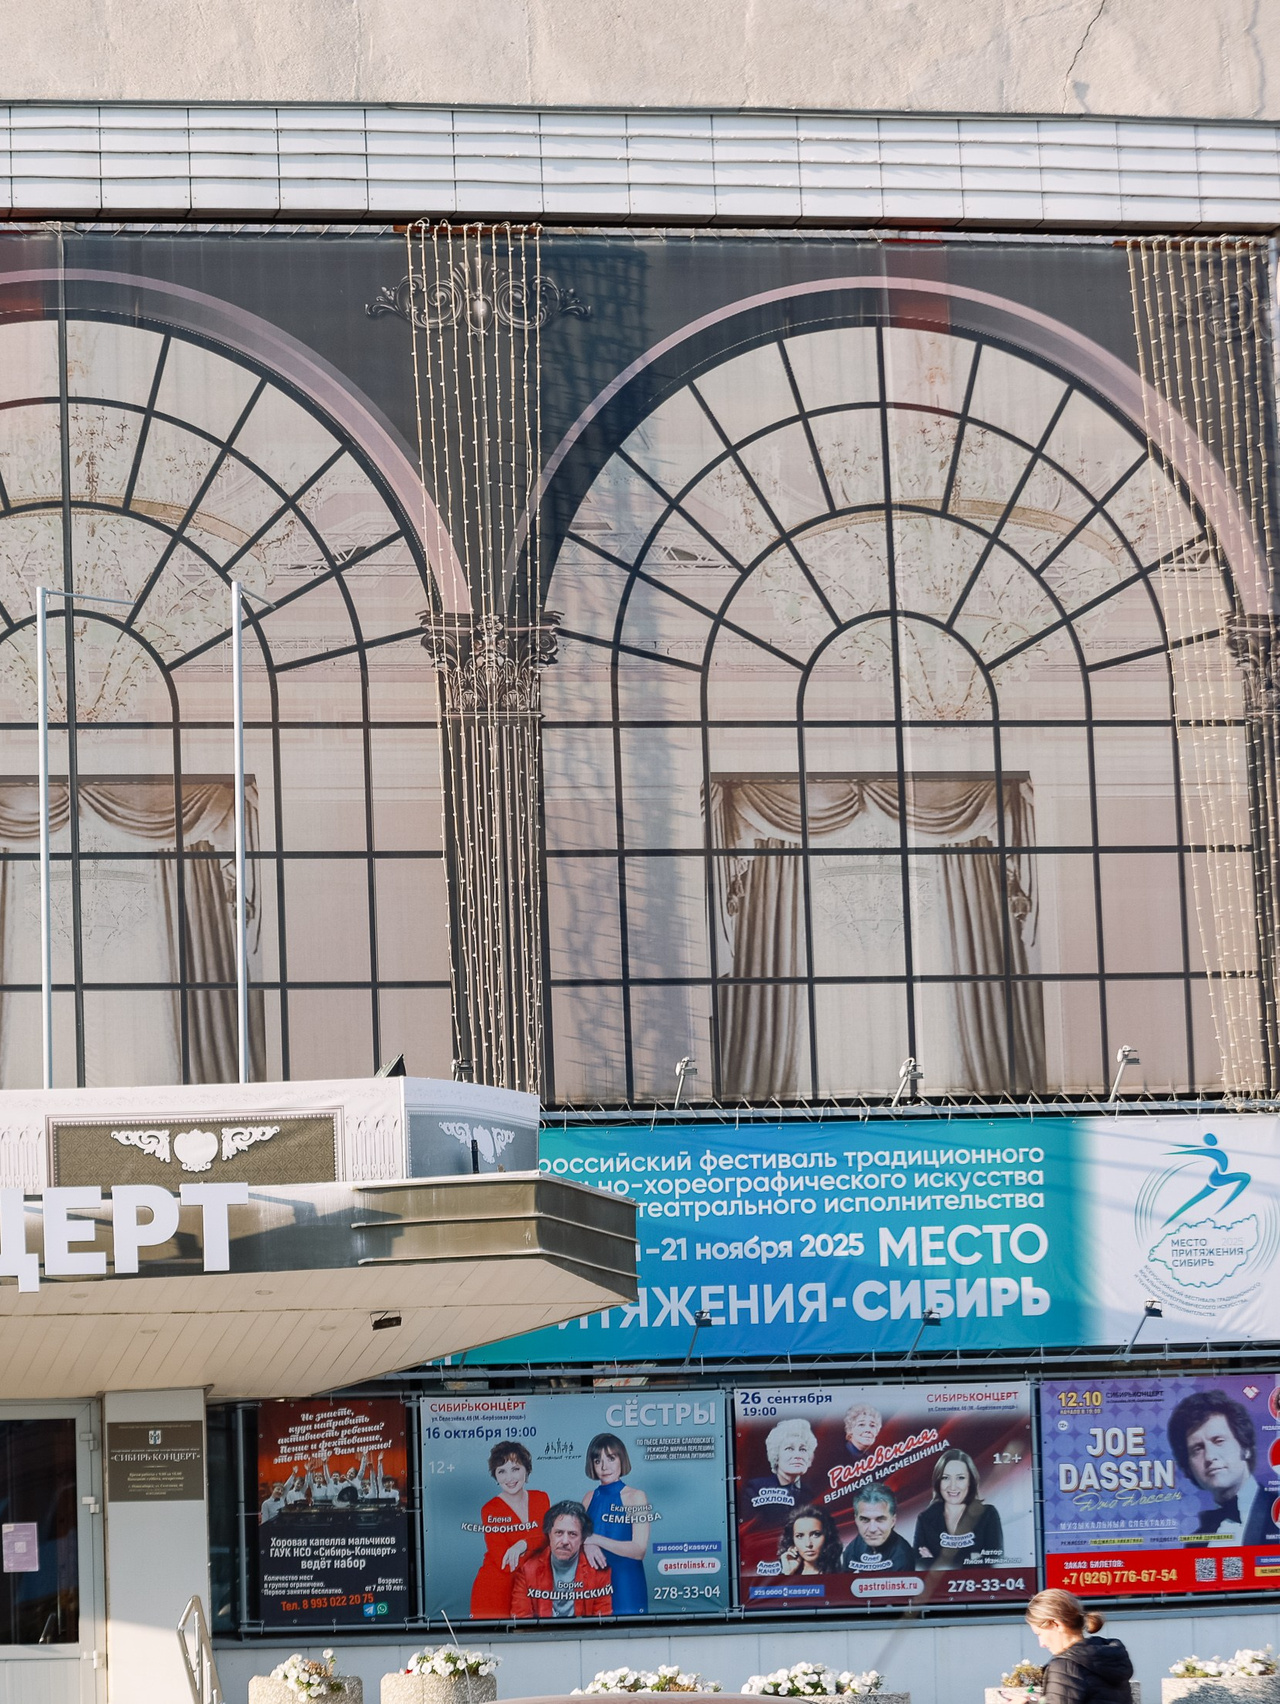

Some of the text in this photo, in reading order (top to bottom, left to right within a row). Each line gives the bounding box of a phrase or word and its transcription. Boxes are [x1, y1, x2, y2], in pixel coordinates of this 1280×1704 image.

[699, 1149, 838, 1176] фестиваль
[844, 1147, 1045, 1172] традиционного
[913, 1169, 1045, 1192] искусства
[824, 1192, 1045, 1213] исполнительства
[695, 1235, 793, 1264] ноября
[799, 1233, 865, 1258] 2025
[878, 1223, 1049, 1267] МЕСТО
[1171, 1238, 1207, 1247] МЕСТО
[1171, 1247, 1244, 1258] ПРИТЯЖЕНИЯ
[1171, 1258, 1214, 1267] СИБИРЬ
[740, 1391, 832, 1405] 26 сентября
[926, 1391, 1019, 1403] СИБИРЬКОНЦЕРТ
[1058, 1391, 1102, 1407] 12.10
[430, 1401, 526, 1413] СИБИРЬКОНЦЕРТ
[605, 1399, 716, 1427] СЁСТРЫ
[743, 1406, 777, 1416] 19:00
[425, 1426, 537, 1441] 16 октября 19:00
[1086, 1427, 1146, 1458] JOE
[992, 1453, 1022, 1464] 12+
[428, 1461, 455, 1474] 12+
[823, 1439, 951, 1504] ВЕЛИКАЯ НАСМЕШНИЦА
[1058, 1460, 1175, 1493] DASSIN
[610, 1503, 653, 1514] Екатерина
[487, 1515, 512, 1524] Елена
[601, 1511, 662, 1525] СЕМЁНОВА
[461, 1520, 539, 1534] КСЕНОФОНТОВА
[270, 1536, 396, 1548] Хоровая капелла мальчиков
[270, 1548, 291, 1558] ГАУК
[293, 1548, 311, 1557] НСО
[301, 1557, 366, 1570] ведёт набор
[664, 1560, 716, 1571] gastrolinsk.ru
[1064, 1559, 1125, 1569] ЗАКАЗ БИЛЕТОВ:
[948, 1577, 1025, 1592] 278-33-04
[1062, 1568, 1178, 1587] +7 (926) 776-67-54
[526, 1584, 614, 1601] ХВОШНЯНСКИЙ
[558, 1581, 583, 1591] Борис
[654, 1585, 721, 1600] 278-33-04
[858, 1580, 918, 1594] gastrolinsk.ru
[281, 1593, 374, 1611] Тел. 8 993 022 20 75
